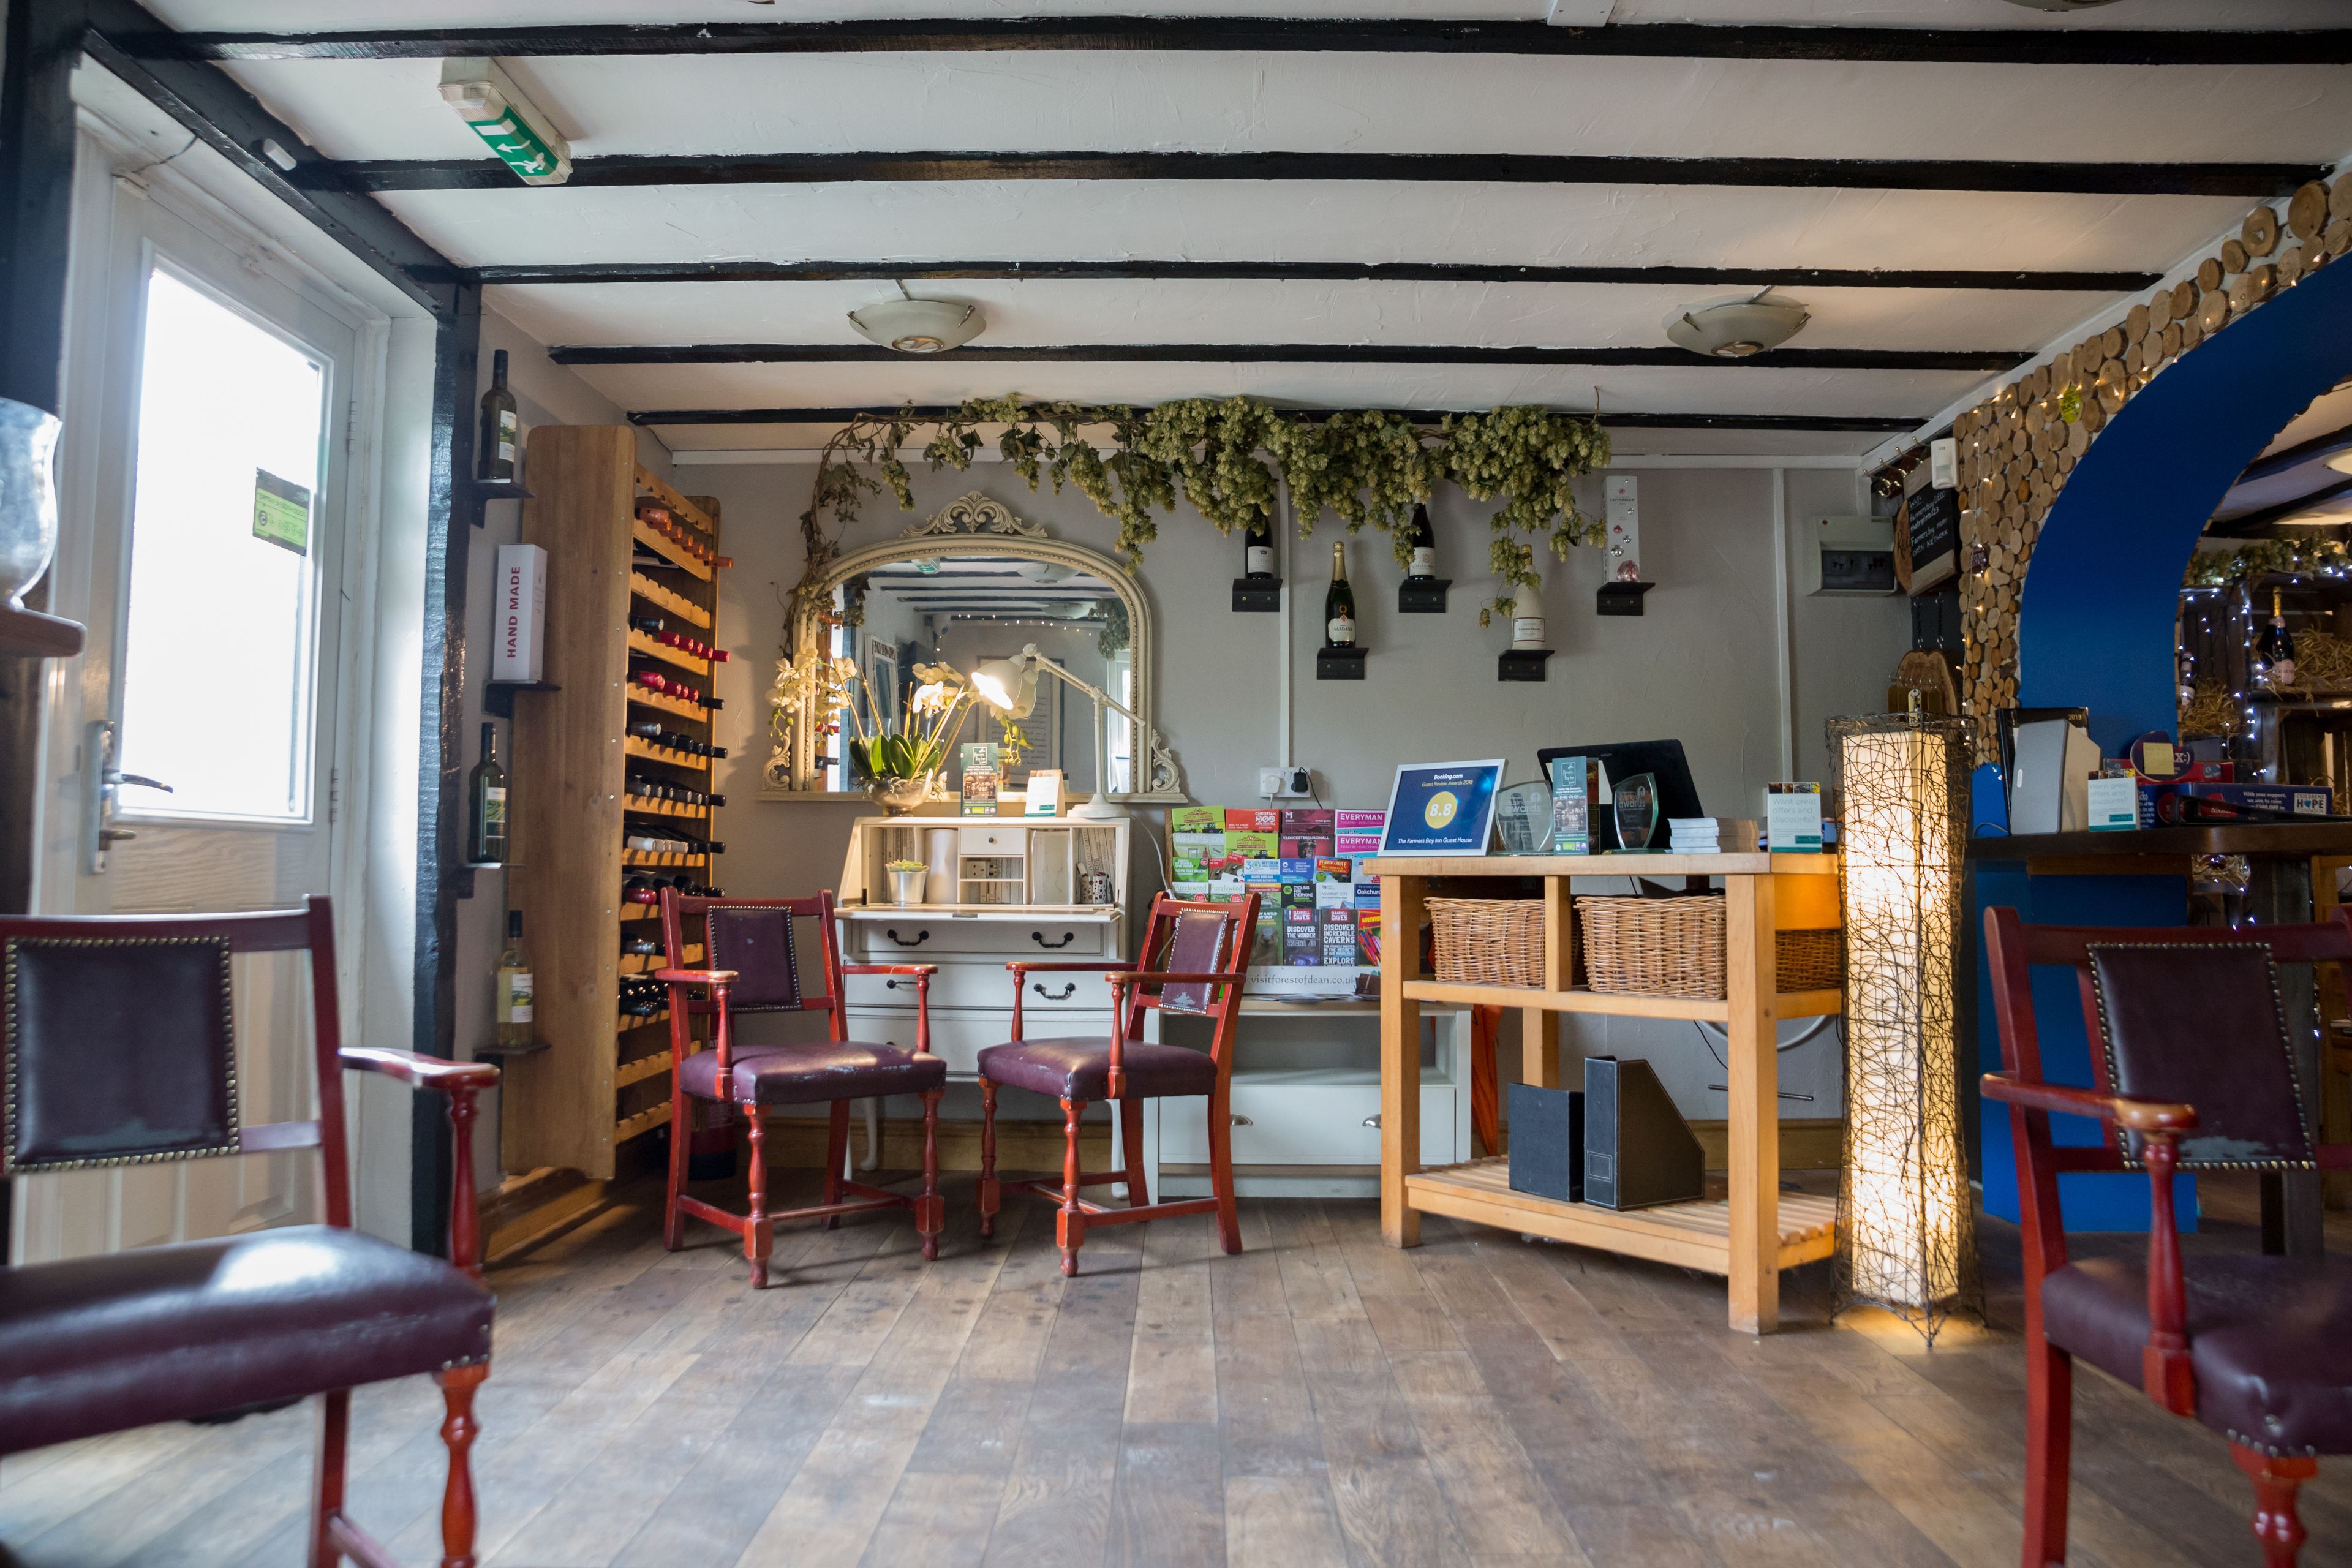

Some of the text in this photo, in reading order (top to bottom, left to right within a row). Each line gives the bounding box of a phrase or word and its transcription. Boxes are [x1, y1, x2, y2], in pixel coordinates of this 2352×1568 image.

[507, 567, 521, 658] HAND MADE
[1618, 799, 1646, 809] awards
[1430, 803, 1452, 816] 8.8
[1176, 834, 1225, 843] WHAT'S ON
[1319, 859, 1347, 868] PERRYGROVE
[1247, 974, 1355, 985] .visitforestofdean.co.uk
